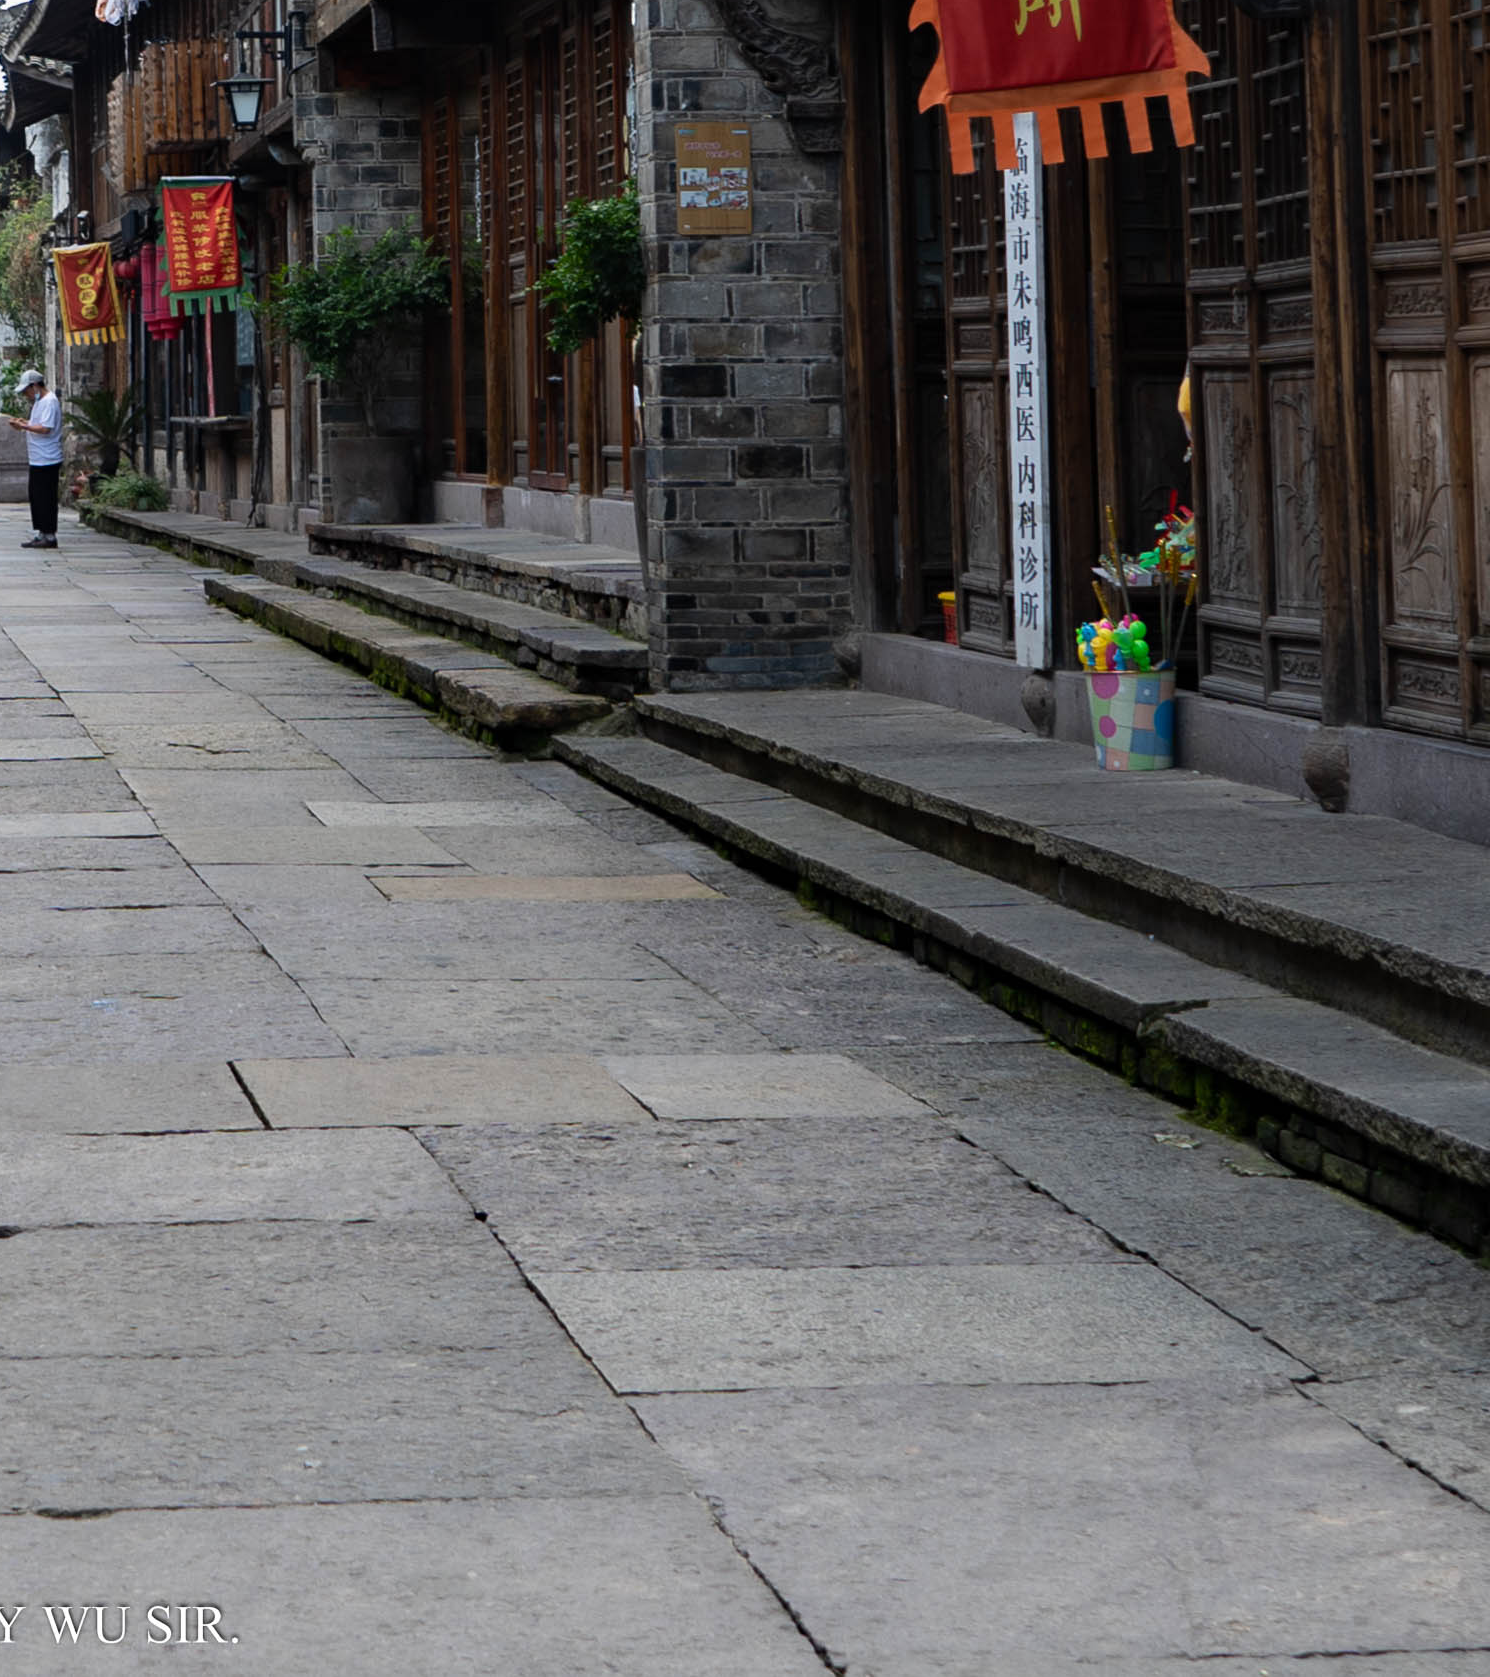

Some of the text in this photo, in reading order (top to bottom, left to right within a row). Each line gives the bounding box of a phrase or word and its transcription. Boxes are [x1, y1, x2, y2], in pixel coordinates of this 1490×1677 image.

[1009, 137, 1040, 631] 临海市朱鸣西医内科诊所
